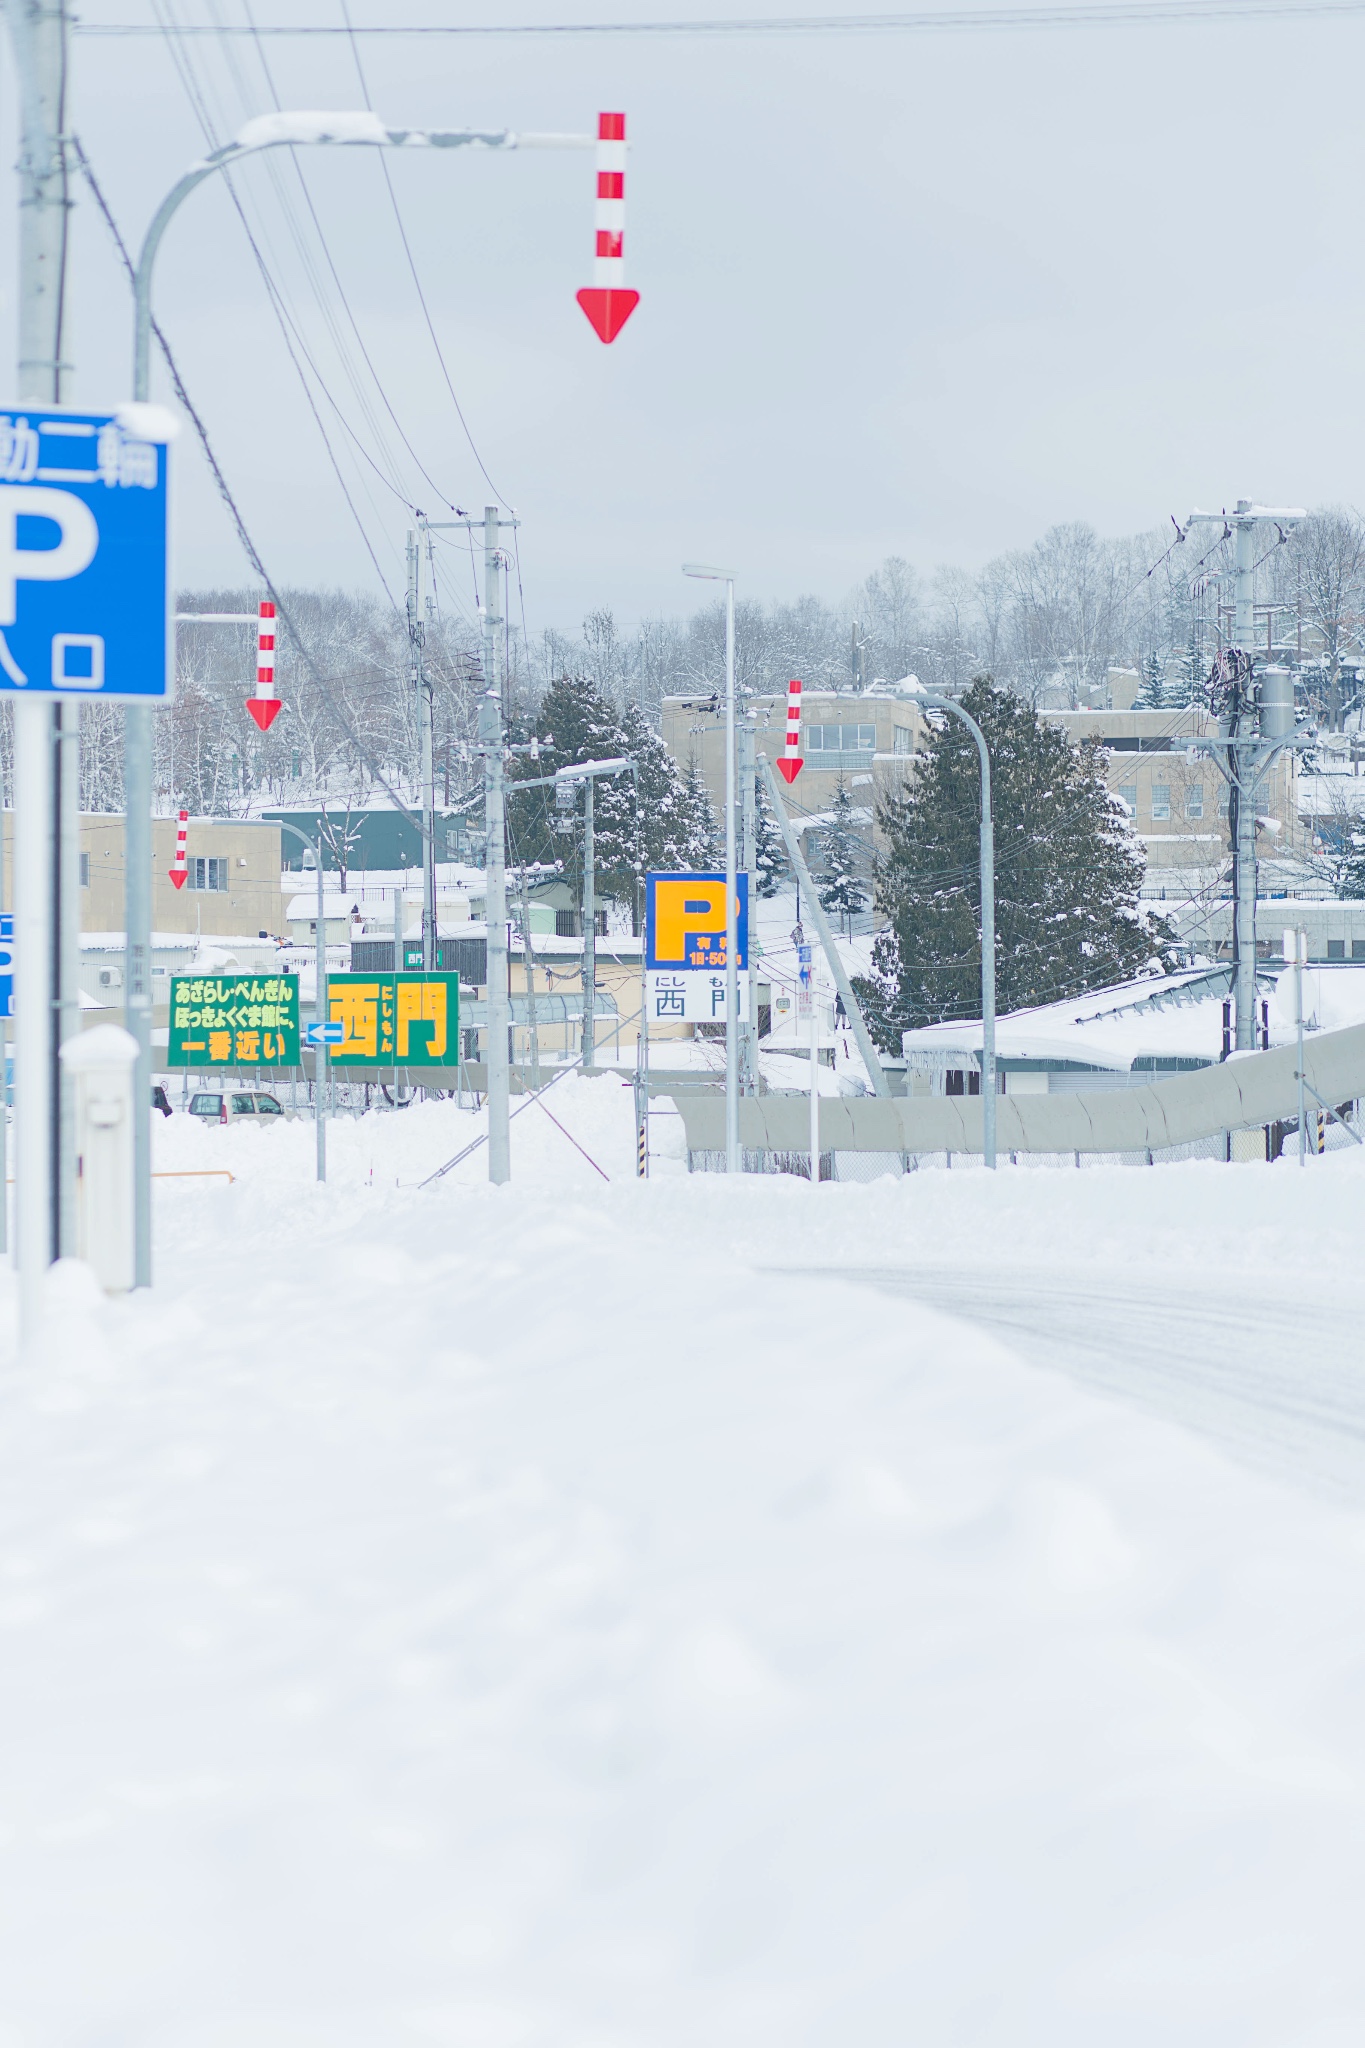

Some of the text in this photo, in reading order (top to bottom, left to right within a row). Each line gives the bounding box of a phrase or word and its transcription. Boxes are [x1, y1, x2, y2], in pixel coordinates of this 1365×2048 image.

[0, 484, 99, 626] P
[655, 880, 741, 961] P
[655, 976, 686, 987] にし
[181, 1030, 286, 1061] 一番近い
[381, 985, 393, 1053] にしもん
